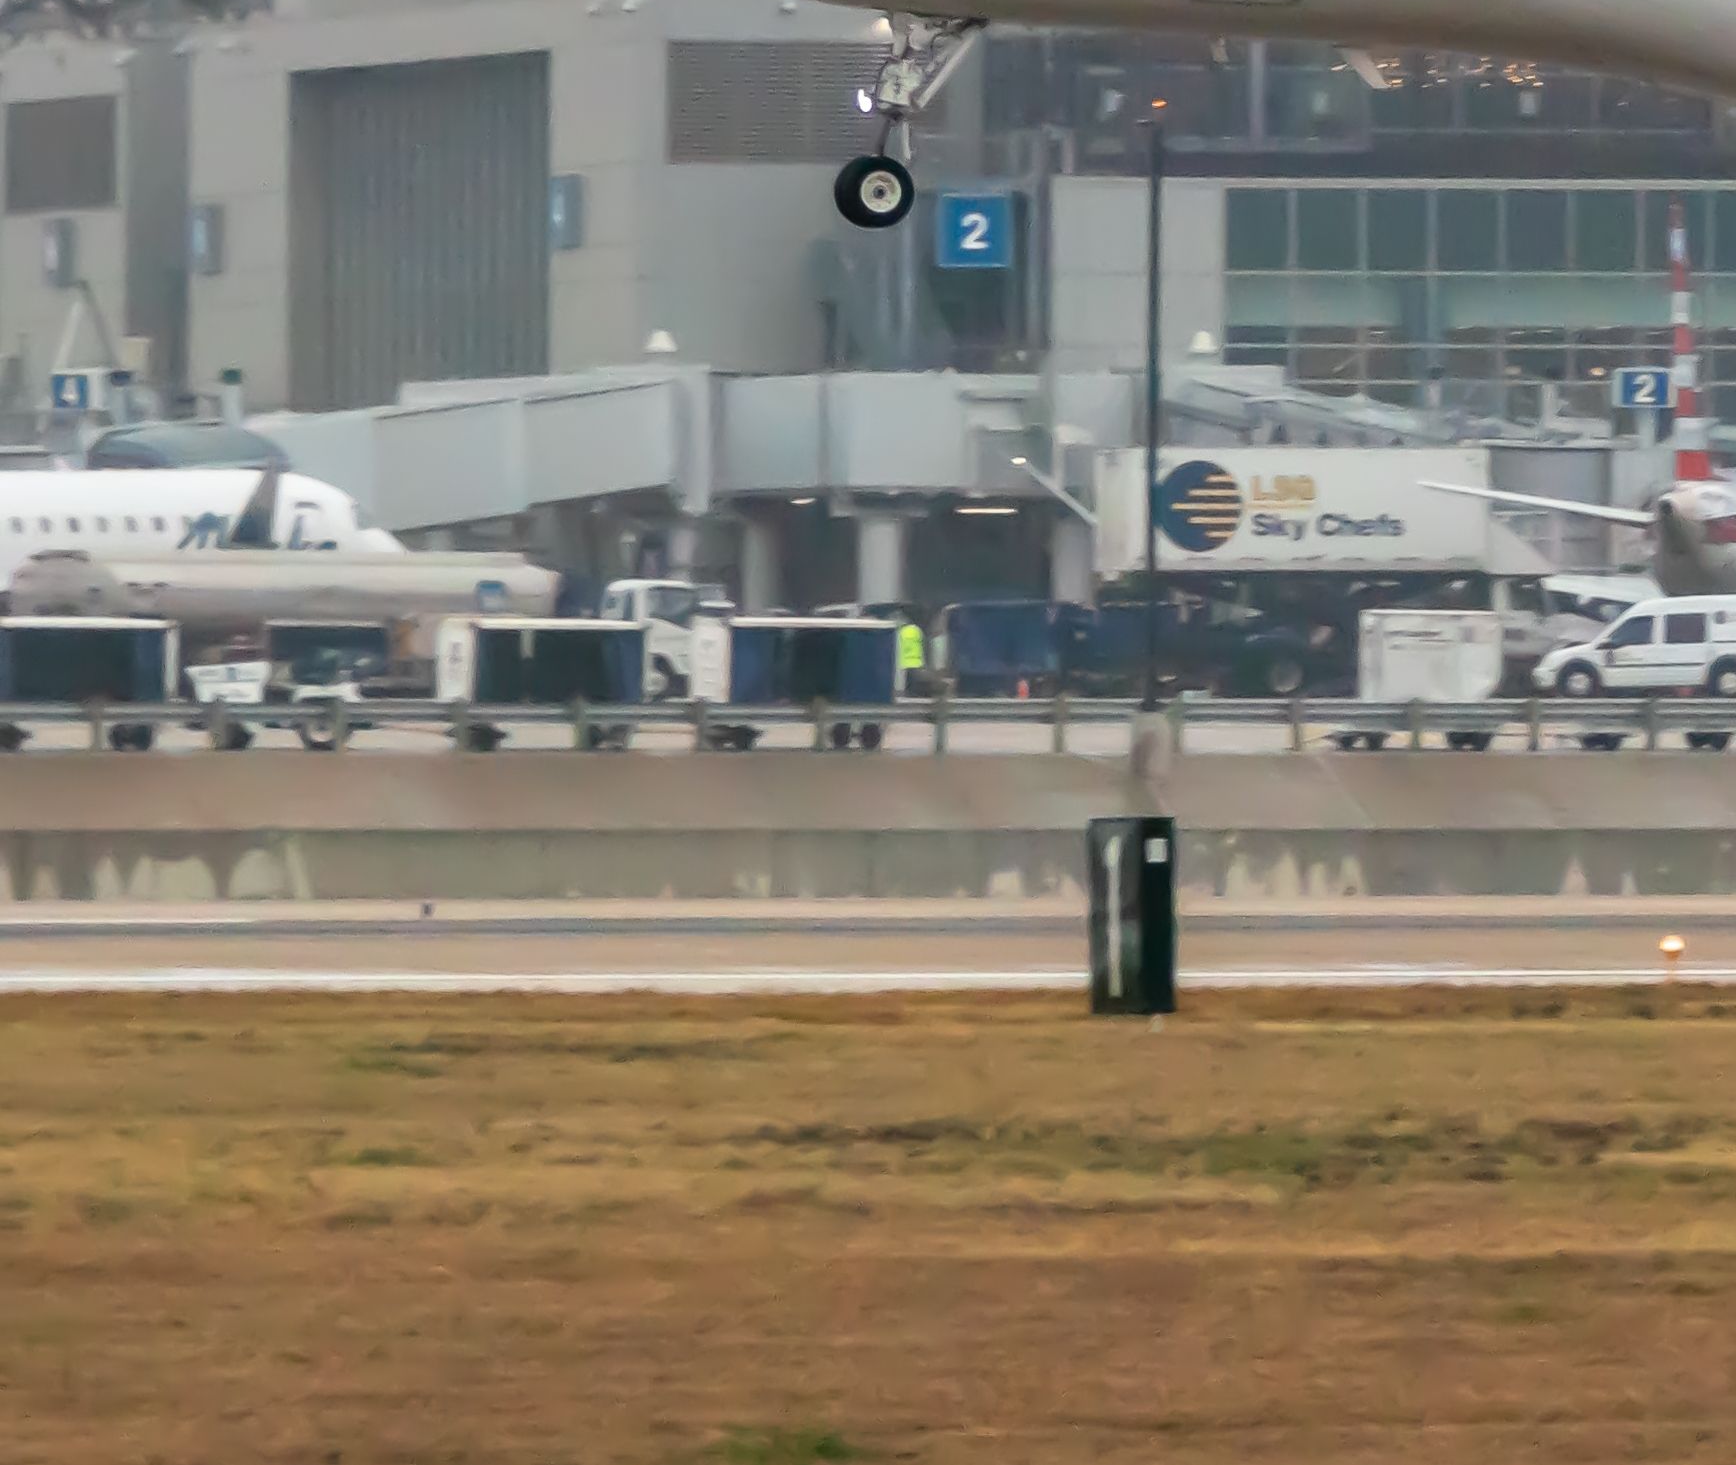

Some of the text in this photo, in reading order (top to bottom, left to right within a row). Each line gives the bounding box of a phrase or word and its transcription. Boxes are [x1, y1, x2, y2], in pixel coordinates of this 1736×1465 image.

[960, 212, 989, 250] 2
[1632, 374, 1656, 404] 2
[1251, 513, 1406, 541] Sky Chefs
